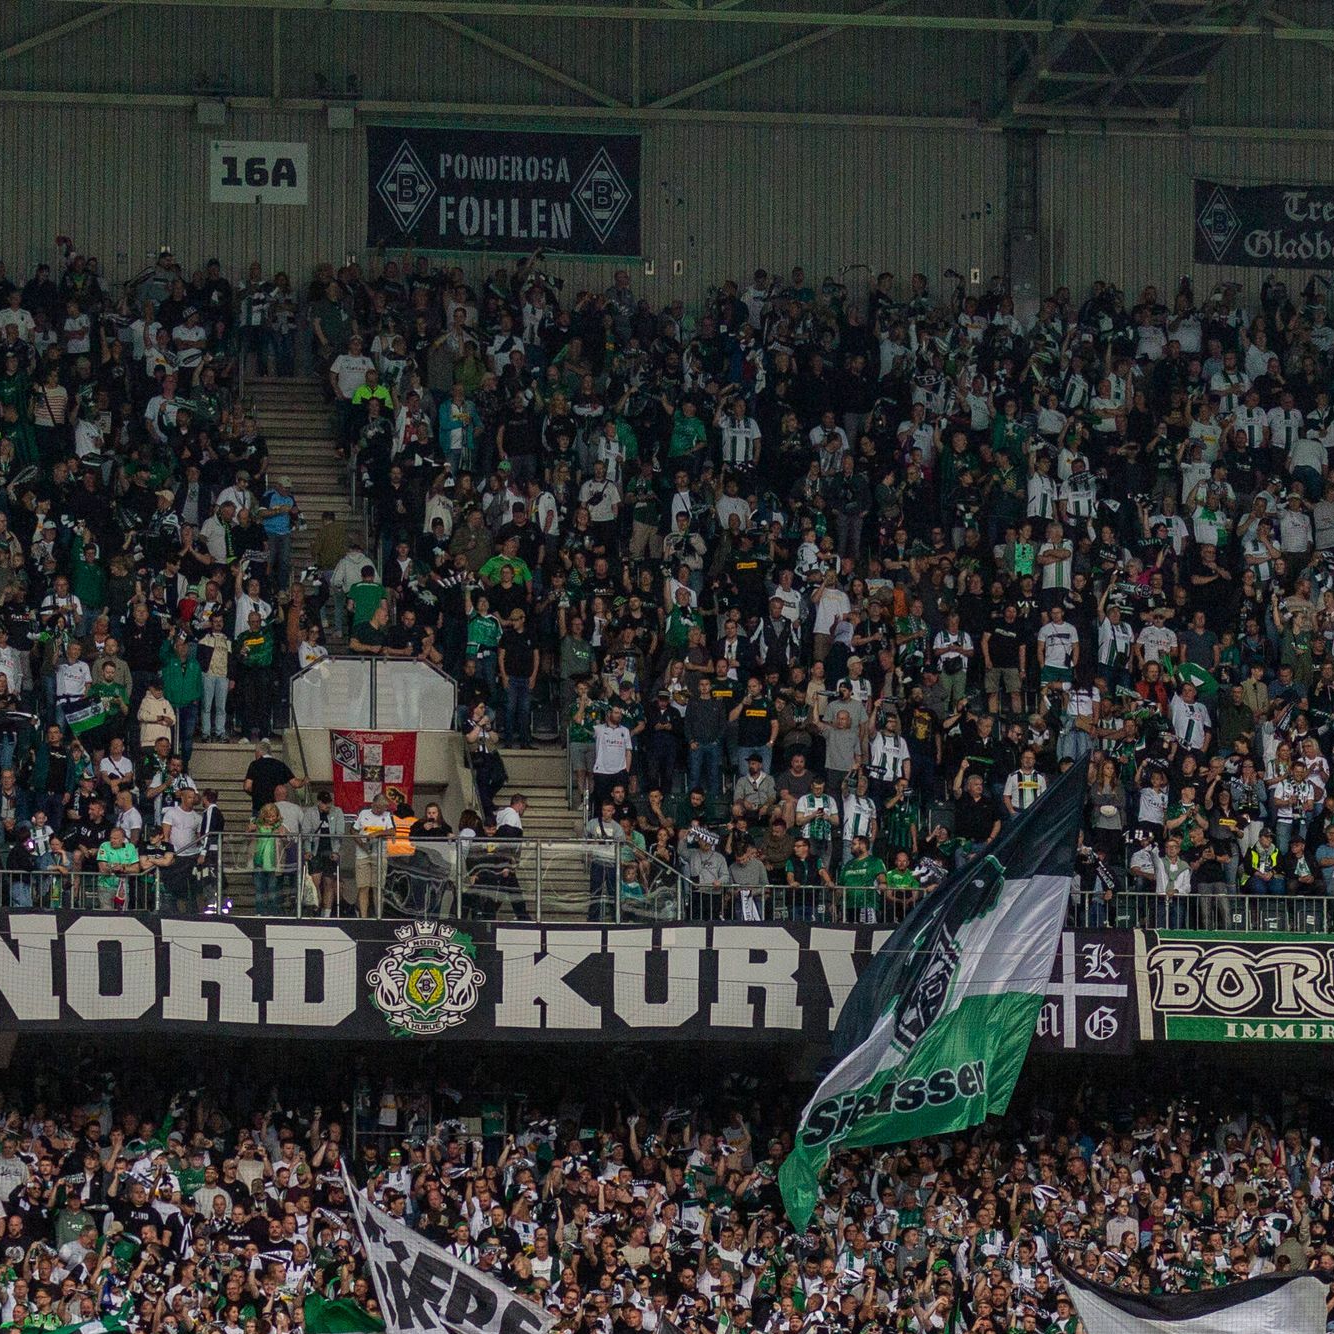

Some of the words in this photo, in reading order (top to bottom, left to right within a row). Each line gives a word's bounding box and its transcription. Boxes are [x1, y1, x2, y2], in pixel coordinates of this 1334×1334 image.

[221, 156, 297, 188] 16A
[438, 153, 571, 184] PONDEROSA
[495, 926, 895, 1031] KURV
